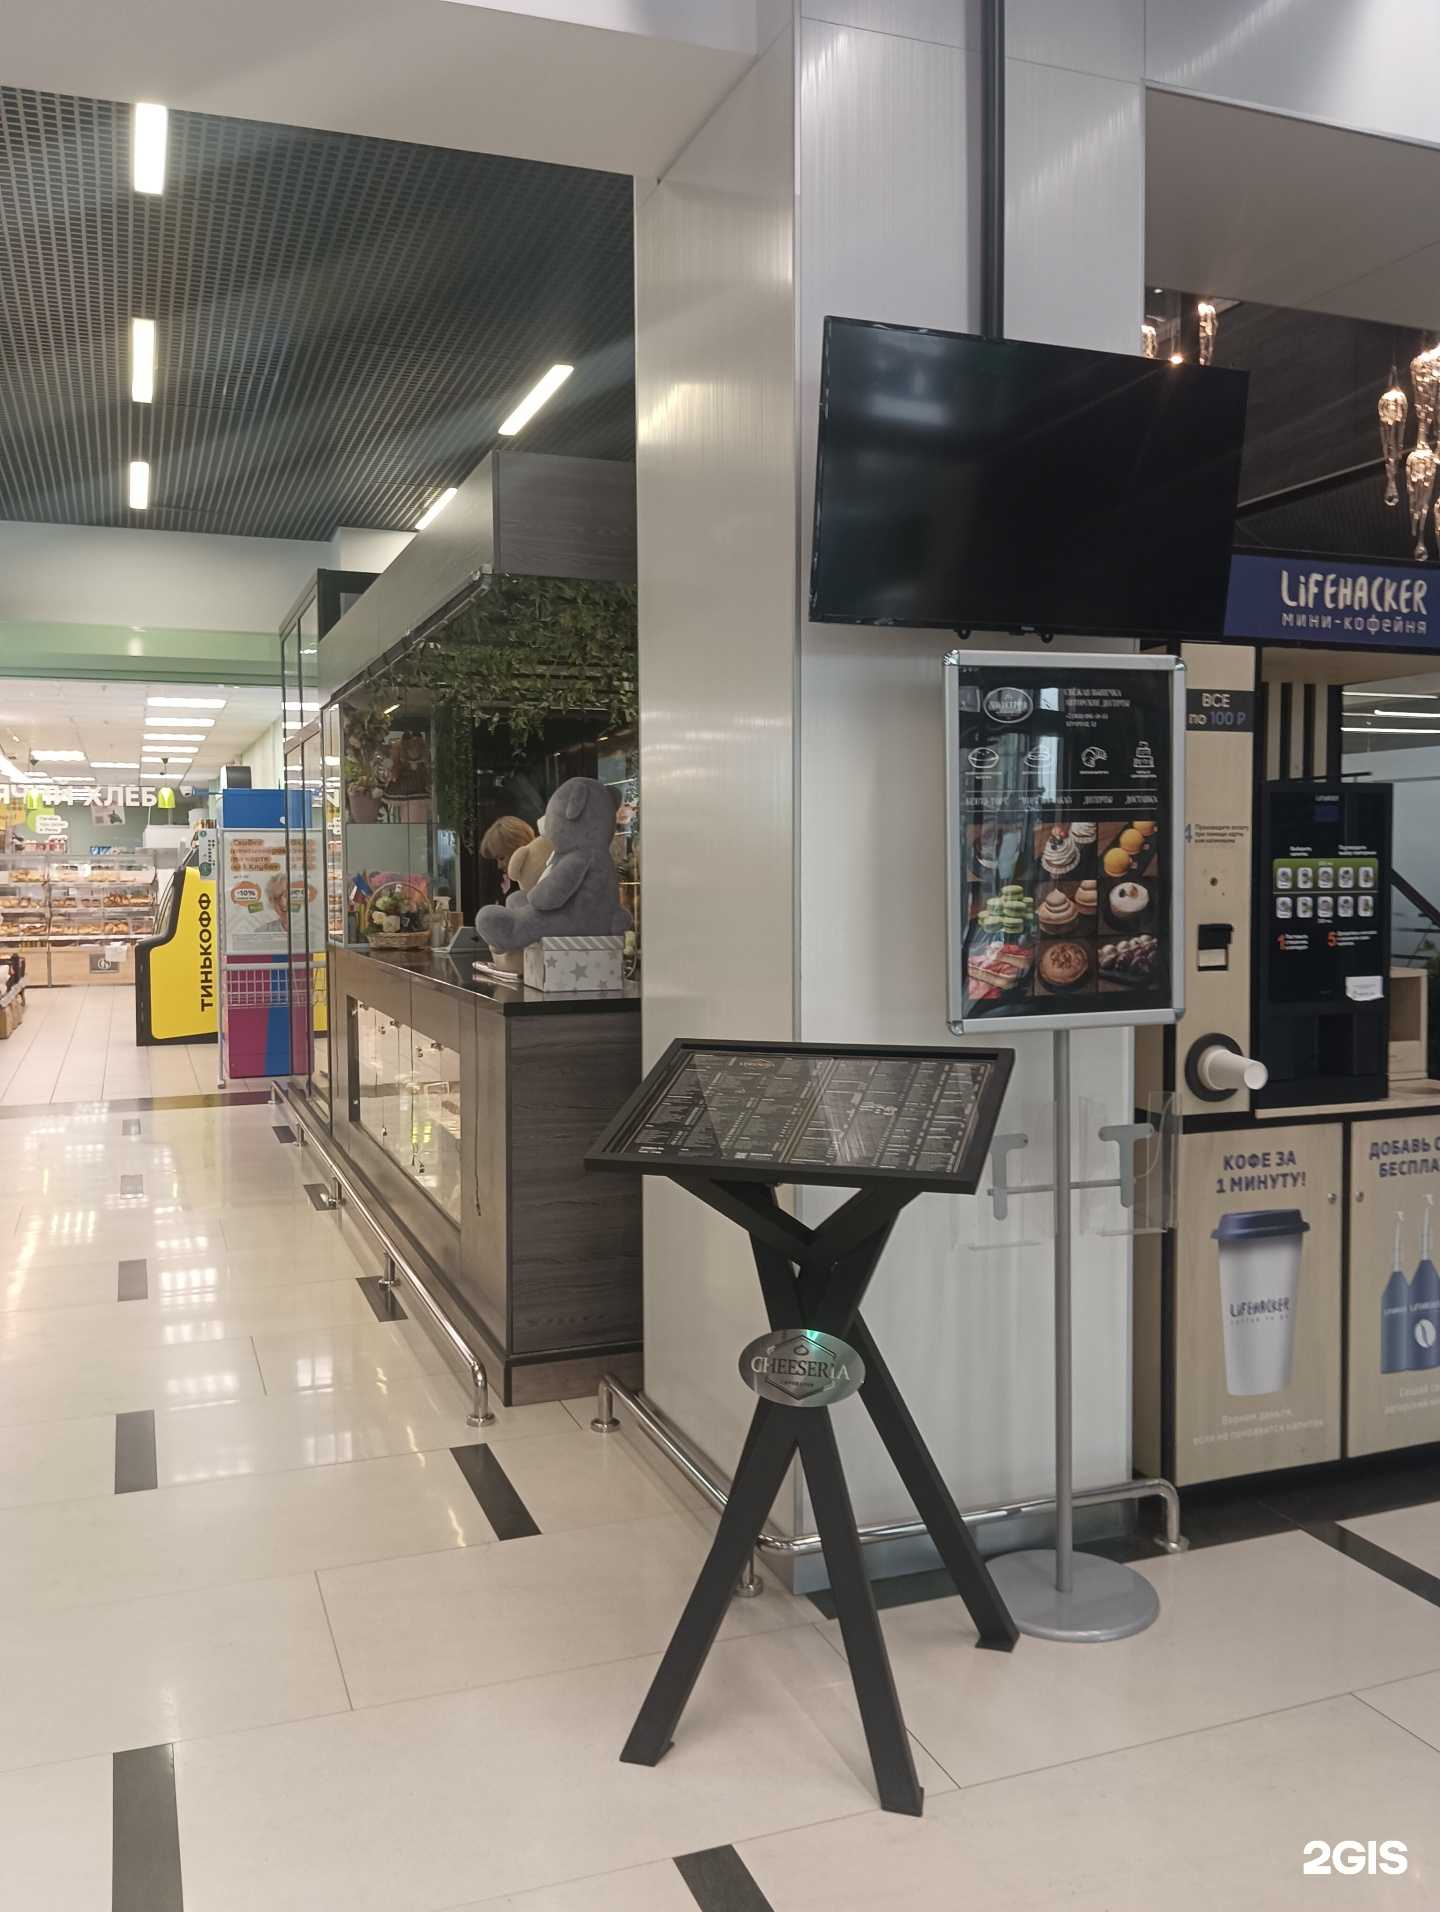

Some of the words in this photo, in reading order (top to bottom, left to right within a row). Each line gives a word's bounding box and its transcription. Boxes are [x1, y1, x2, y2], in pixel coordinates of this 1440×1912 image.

[1201, 692, 1231, 708] ВСЕ
[1210, 711, 1234, 726] 100
[84, 785, 158, 807] ХЛЕБ
[199, 893, 214, 1012] ТИНЬКОФФ
[1369, 1138, 1431, 1160] ДОБАВЬ
[1223, 1152, 1271, 1171] КОФЕ
[1275, 1150, 1297, 1167] ЗА
[1216, 1178, 1226, 1194] 1
[1230, 1171, 1306, 1192] МИНУТУ!
[751, 1356, 850, 1380] CHEESERIA
